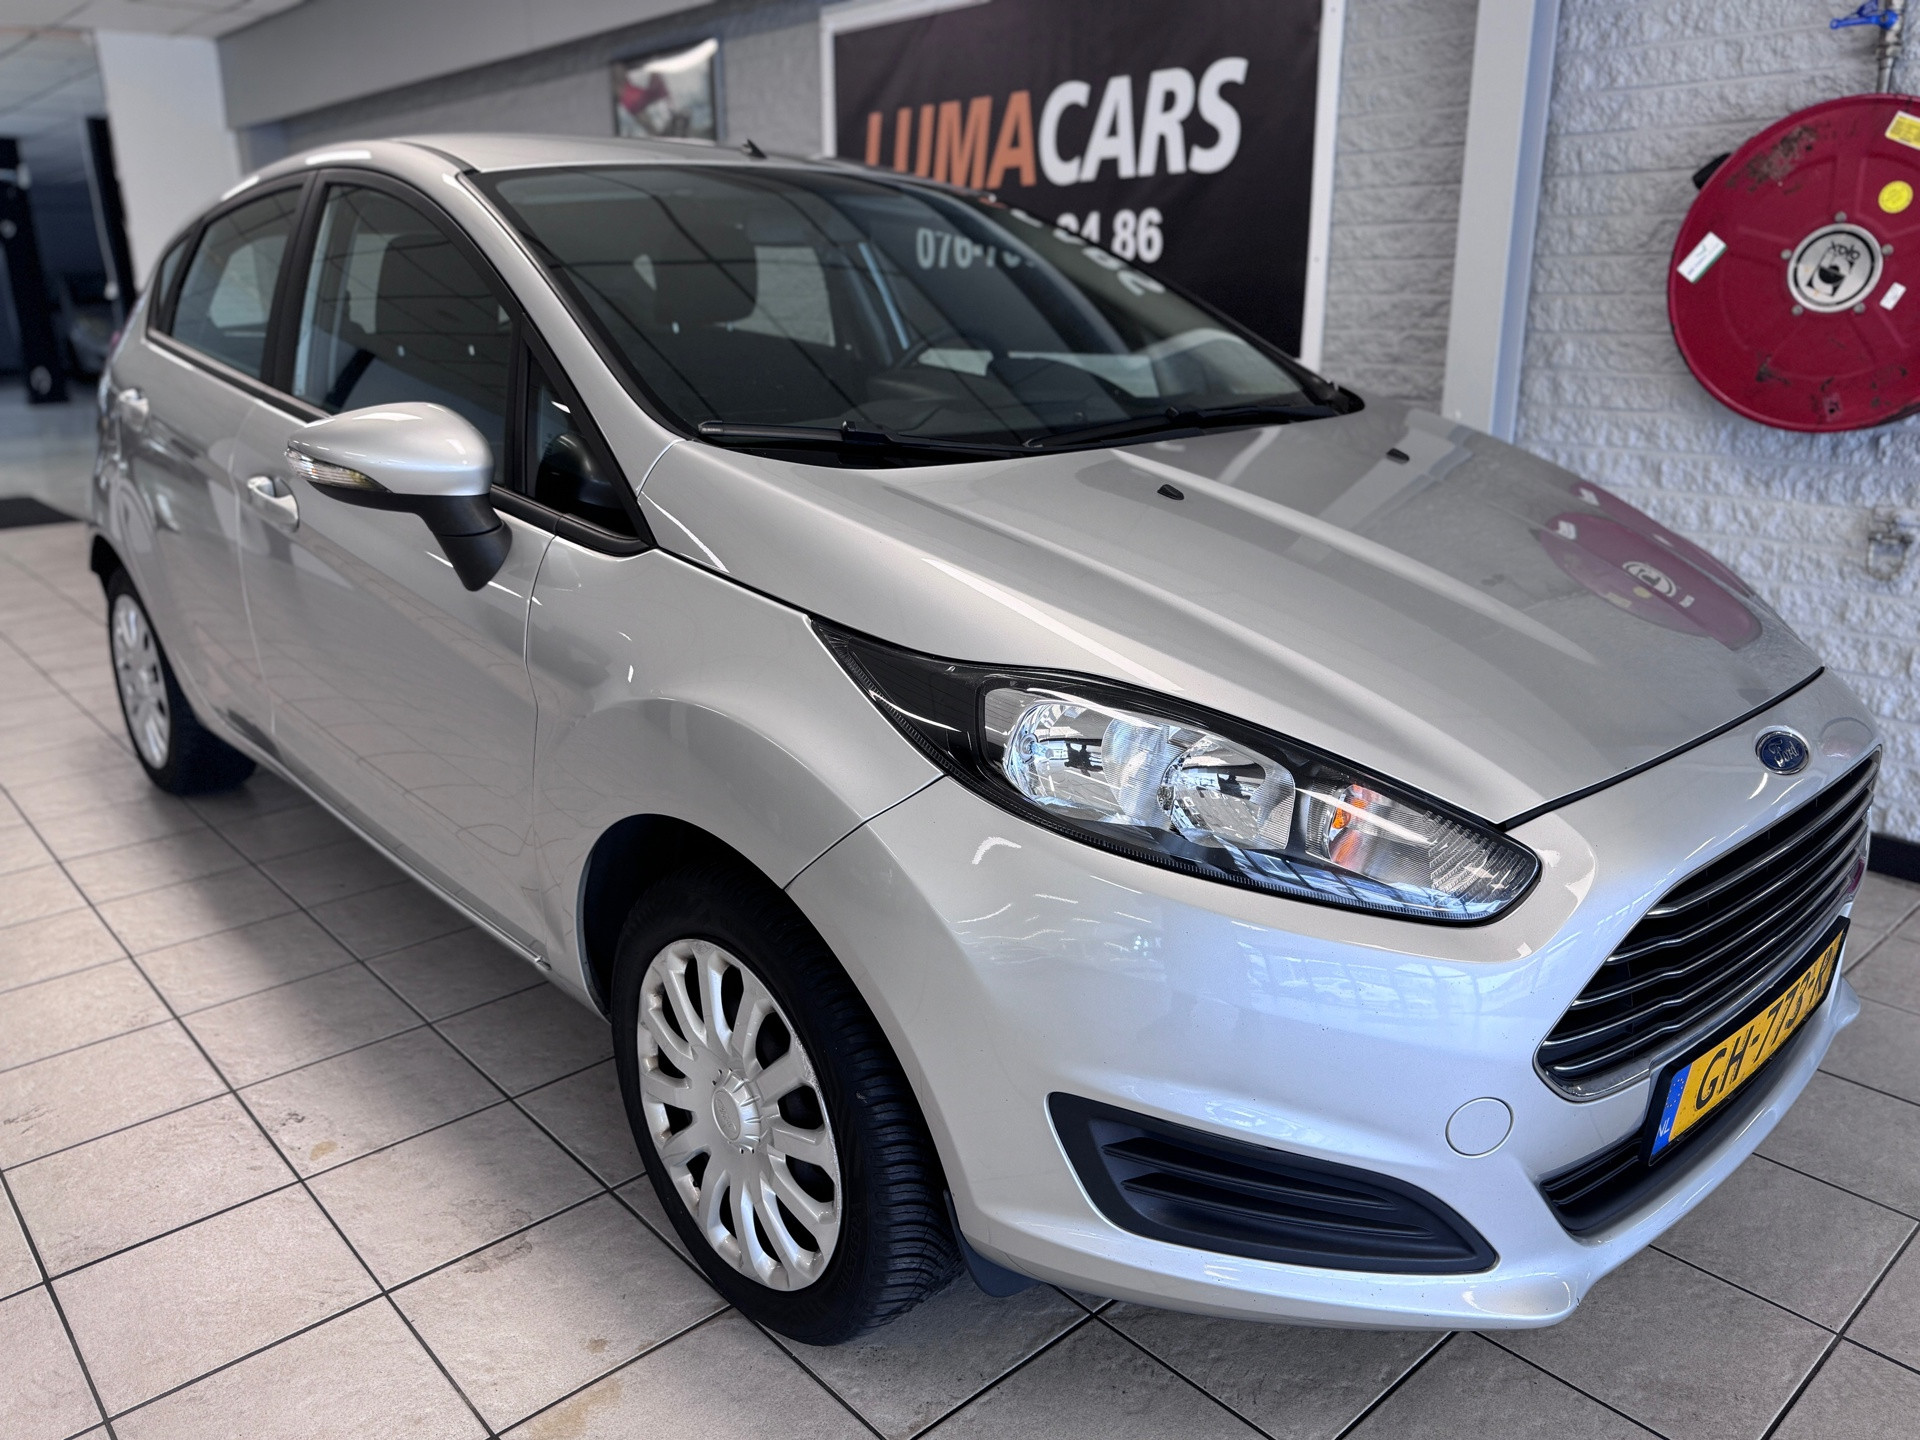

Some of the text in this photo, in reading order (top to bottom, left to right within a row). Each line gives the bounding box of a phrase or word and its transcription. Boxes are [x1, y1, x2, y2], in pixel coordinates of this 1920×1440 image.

[915, 227, 1038, 270] 076-
[1111, 207, 1164, 264] 86
[1658, 946, 1834, 1138] NL GH-773-R
